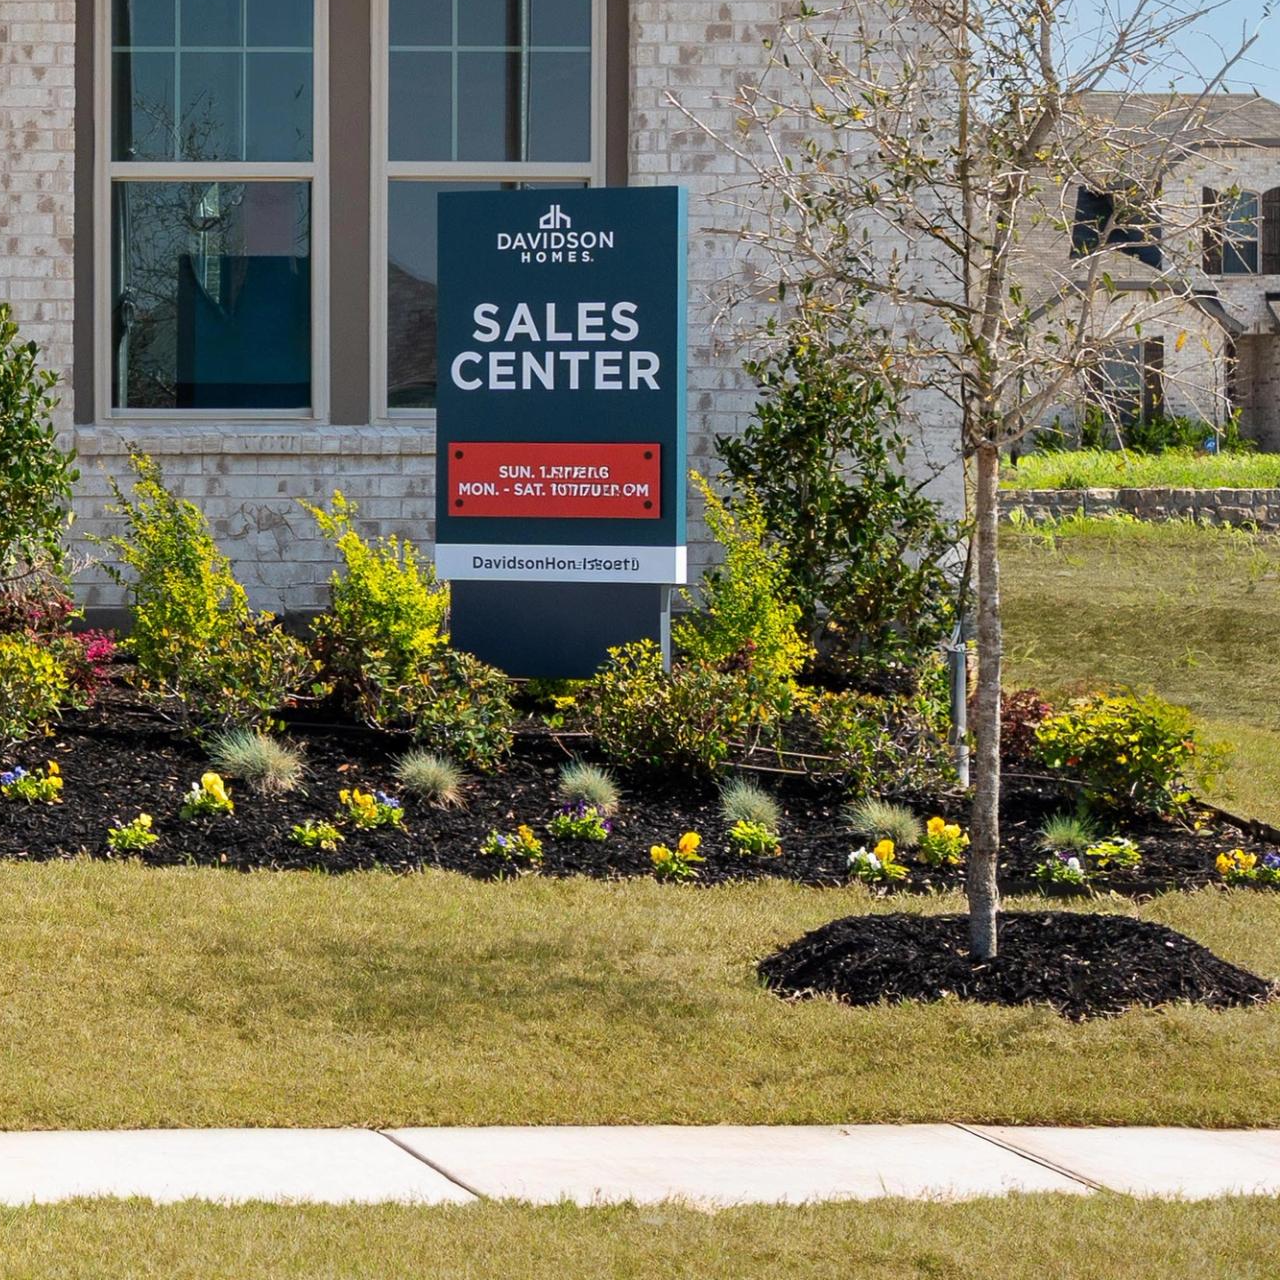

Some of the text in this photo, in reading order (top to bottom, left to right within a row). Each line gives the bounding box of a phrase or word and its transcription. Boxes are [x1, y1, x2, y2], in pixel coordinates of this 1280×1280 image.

[497, 231, 614, 250] DAVIDSON
[472, 300, 640, 343] SALES
[450, 350, 661, 391] CENTER
[499, 465, 535, 479] SUN.
[458, 482, 500, 496] MON.
[513, 483, 546, 497] SAT.
